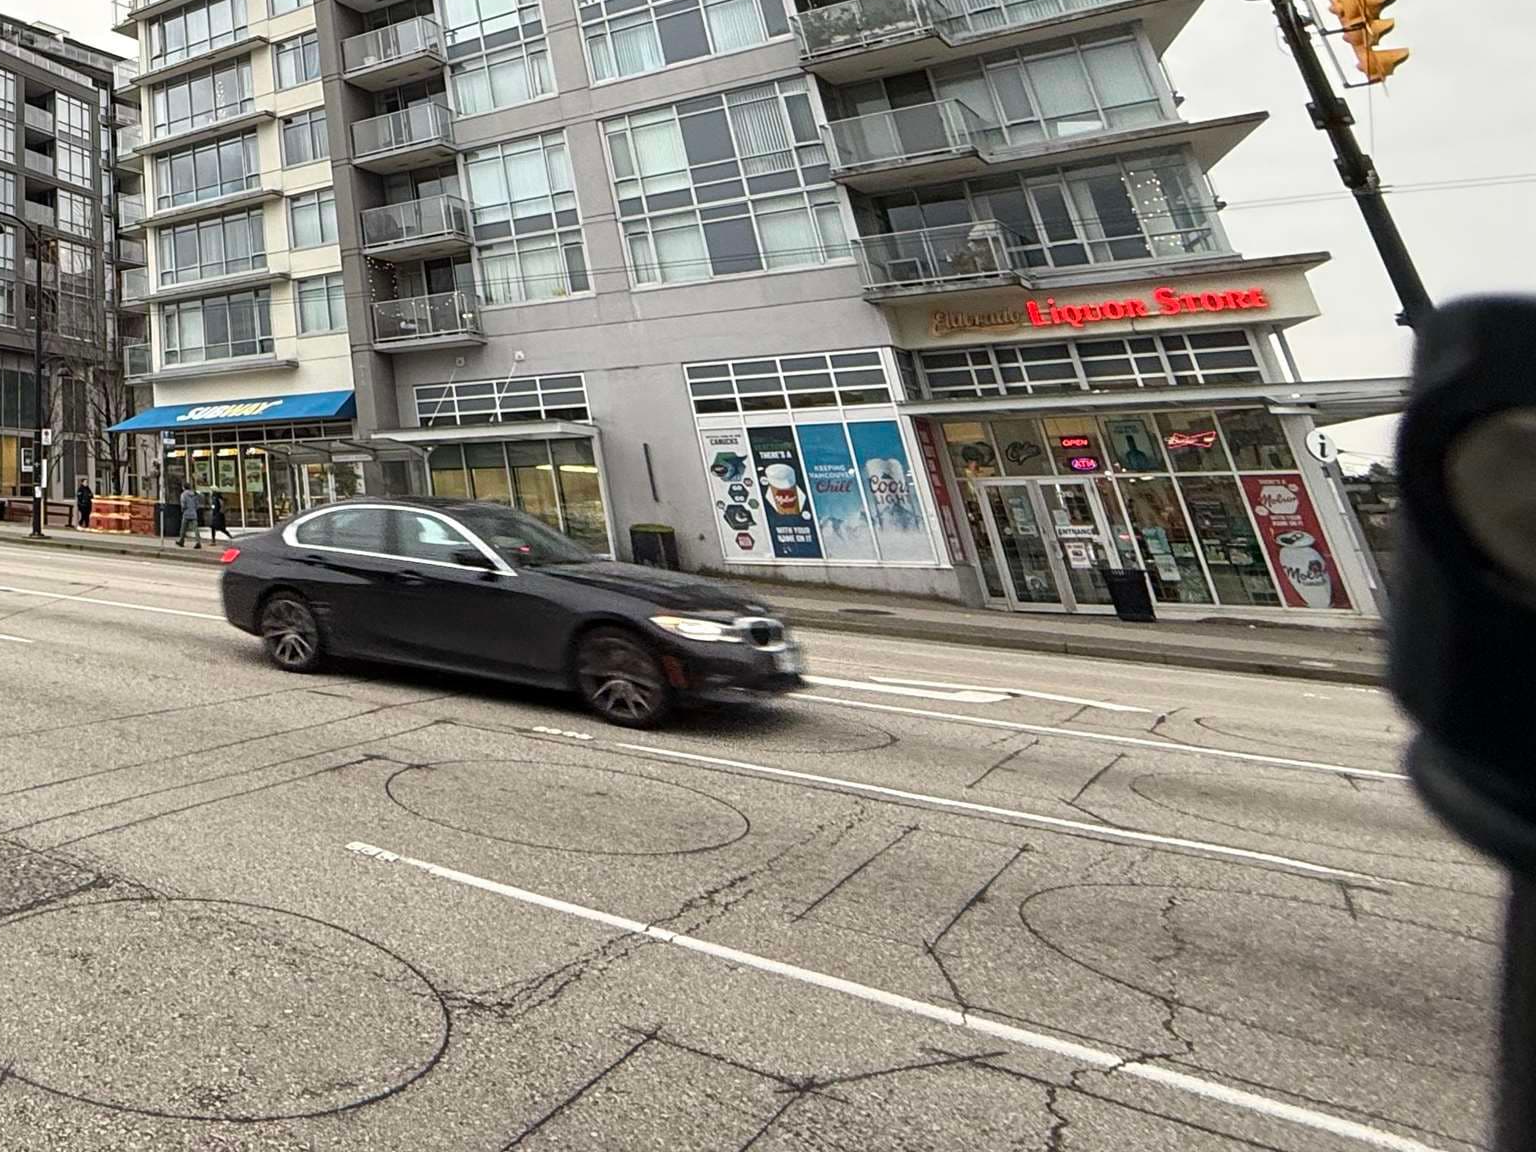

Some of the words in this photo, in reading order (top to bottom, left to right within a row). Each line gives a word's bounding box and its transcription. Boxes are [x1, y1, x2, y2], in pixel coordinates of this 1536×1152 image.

[177, 400, 283, 422] SUBWAY
[1062, 439, 1088, 447] OPEN
[814, 464, 846, 472] KEEPING
[816, 479, 853, 493] Chill
